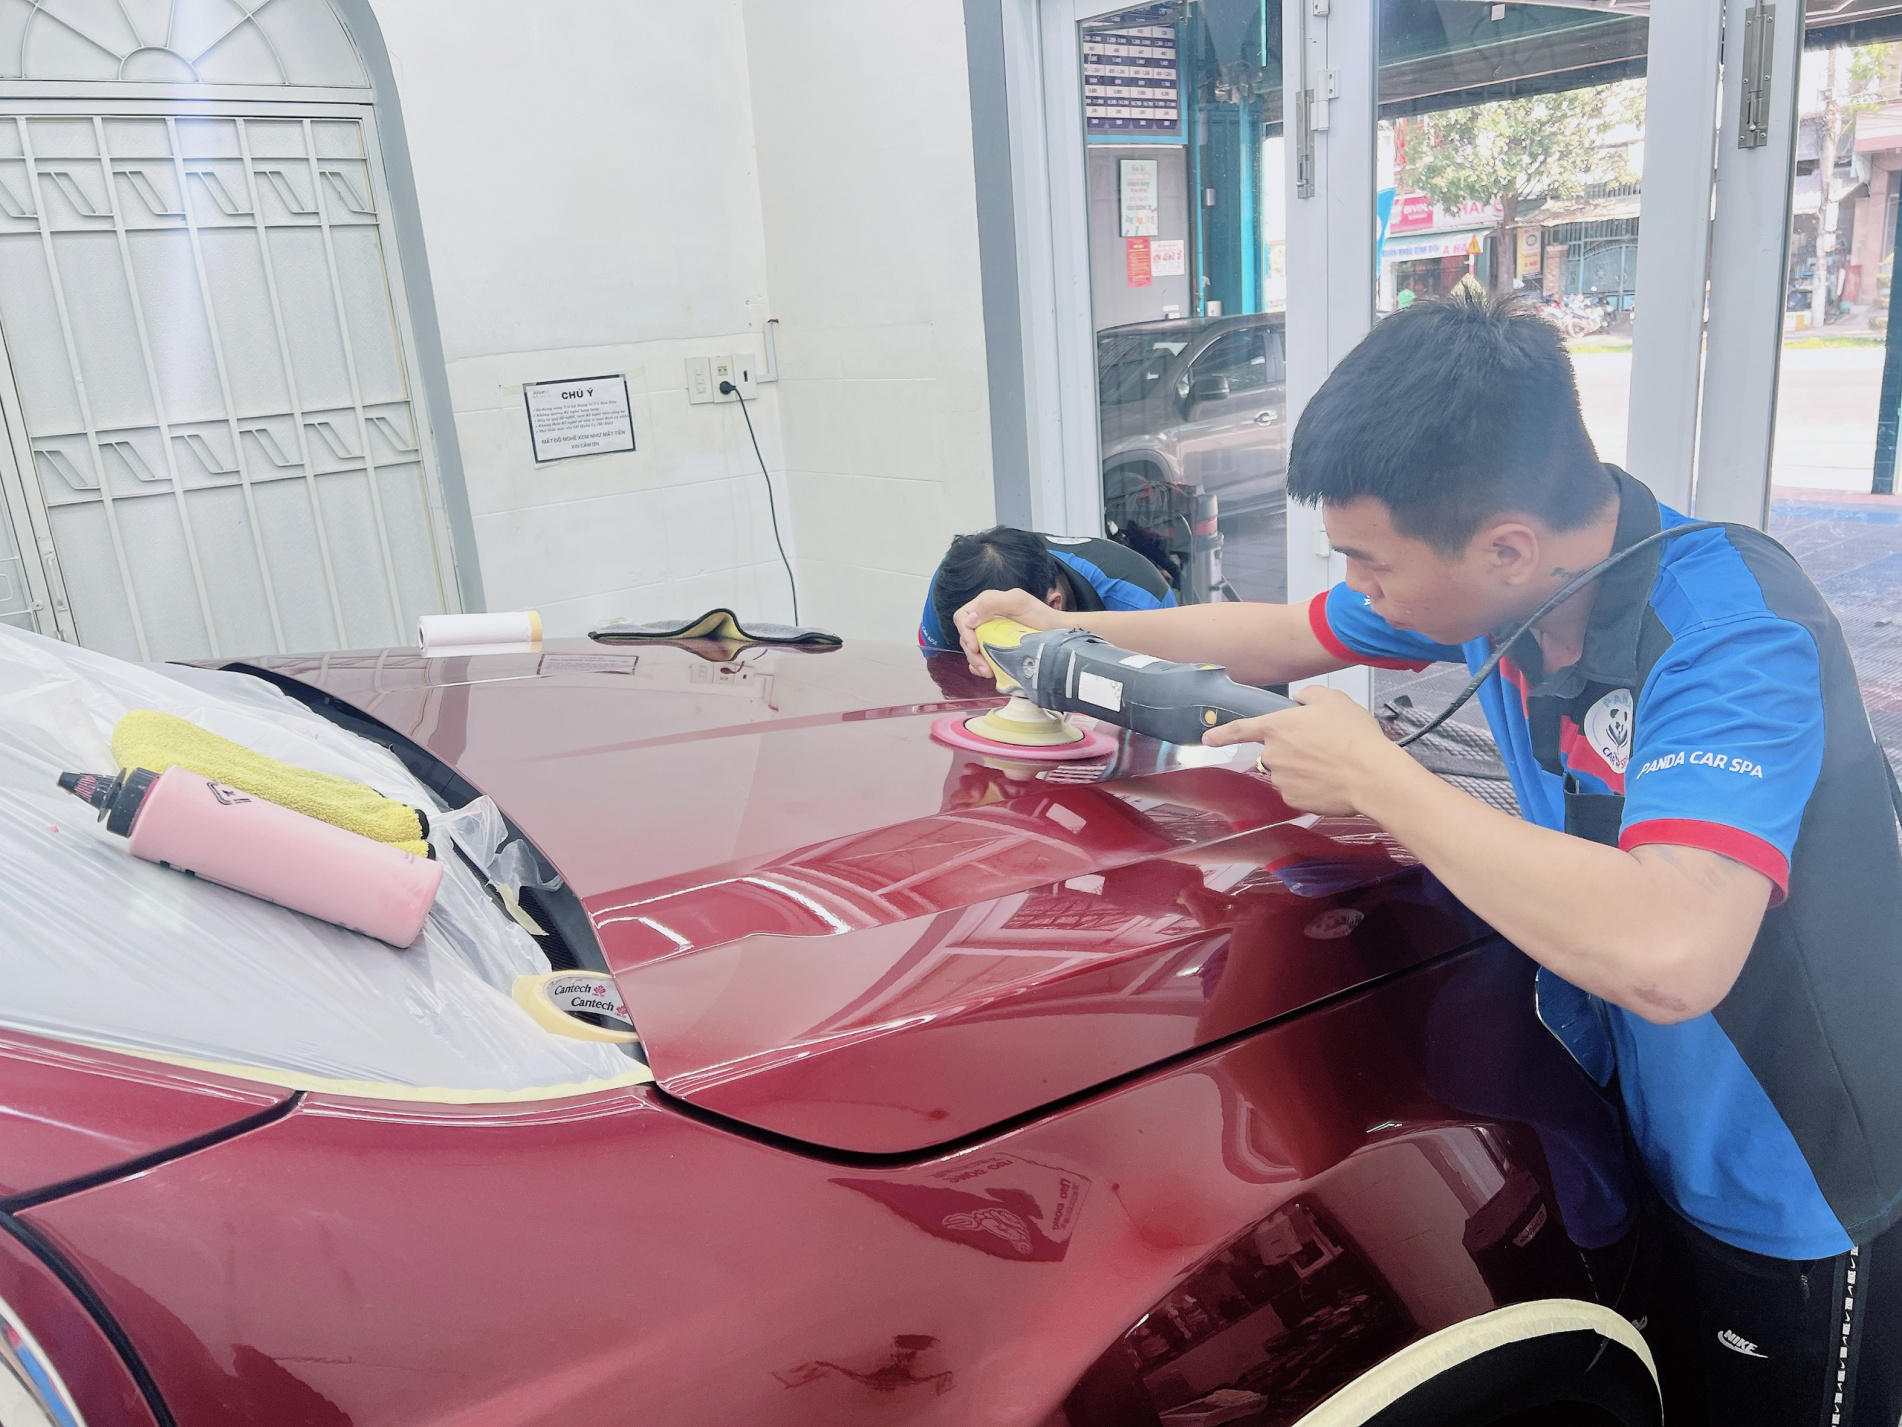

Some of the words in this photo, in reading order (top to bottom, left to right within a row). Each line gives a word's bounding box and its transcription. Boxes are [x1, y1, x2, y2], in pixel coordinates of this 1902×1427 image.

[561, 388, 584, 400] CHÚ
[586, 387, 594, 397] Ý
[1636, 751, 1685, 780] PANDA
[1689, 751, 1728, 770] CAR
[1728, 758, 1763, 779] SPA
[554, 984, 591, 995] Cantech
[571, 997, 614, 1012] Cantech
[1723, 1329, 1758, 1352] NIKE
